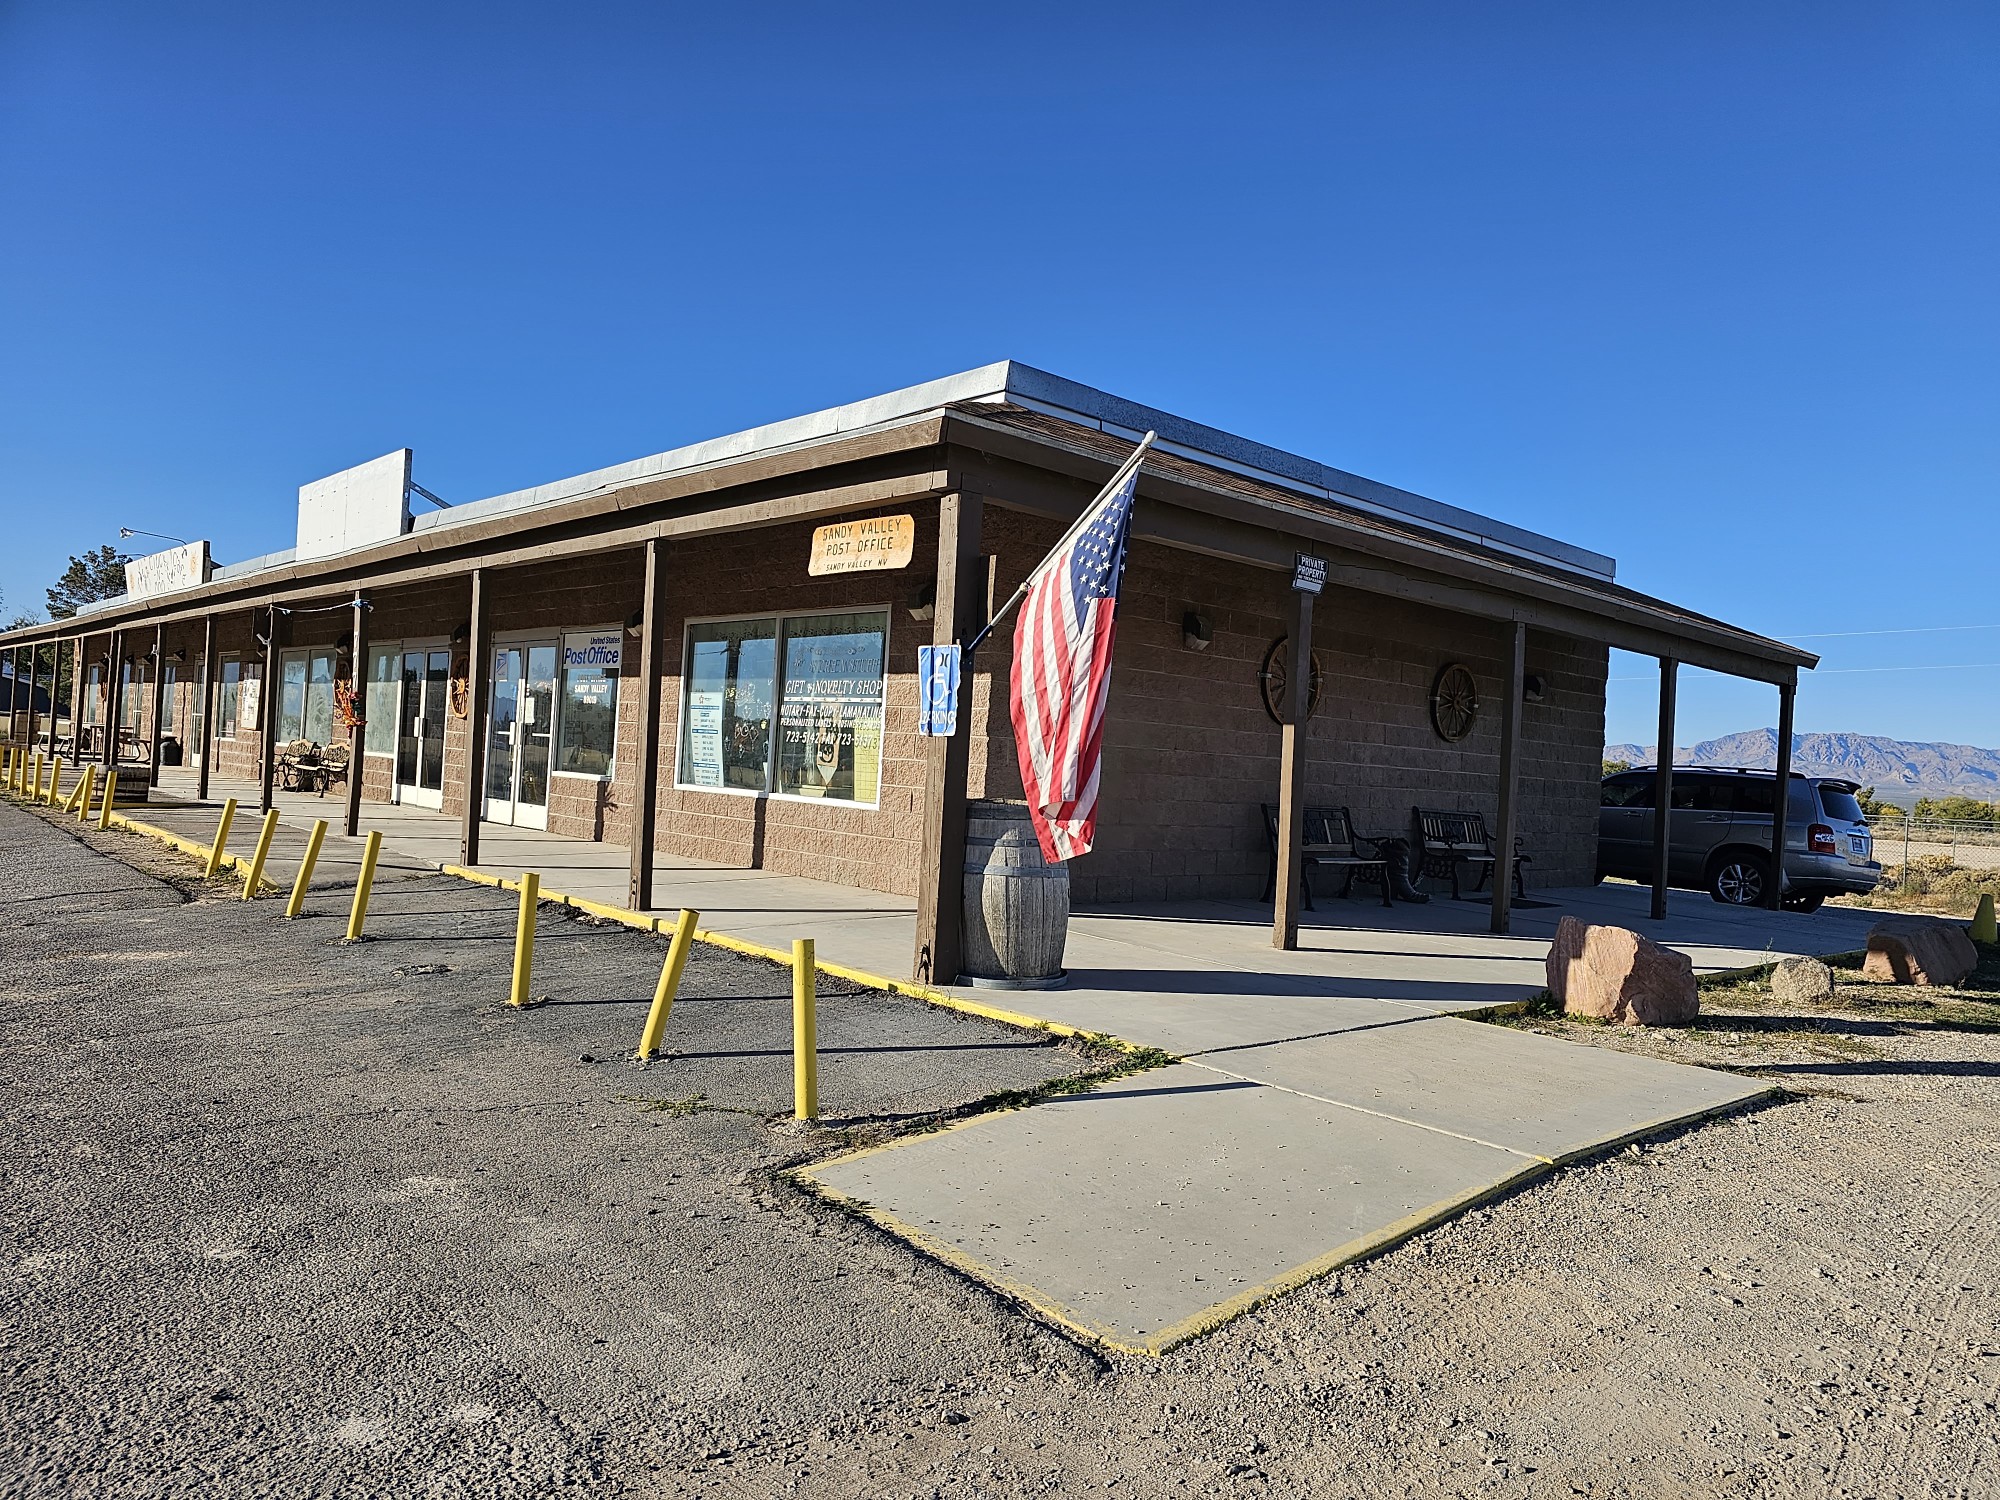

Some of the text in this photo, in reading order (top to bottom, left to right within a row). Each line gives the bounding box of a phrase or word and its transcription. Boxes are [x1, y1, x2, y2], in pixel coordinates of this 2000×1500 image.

[822, 518, 902, 541] SANDY VALLEY
[826, 536, 894, 556] POST OFFICE
[825, 558, 888, 571] SANDY VALLEY NV
[1301, 556, 1324, 570] PRIVATE
[1297, 564, 1327, 580] PROPERTY
[590, 635, 621, 645] United States
[564, 646, 619, 665] Post Office
[574, 684, 608, 694] SANDY VALLEY
[785, 680, 806, 694] GIFT
[814, 680, 856, 695] NOVELTY
[856, 680, 883, 695] SHOP
[786, 730, 821, 744] 723-5142
